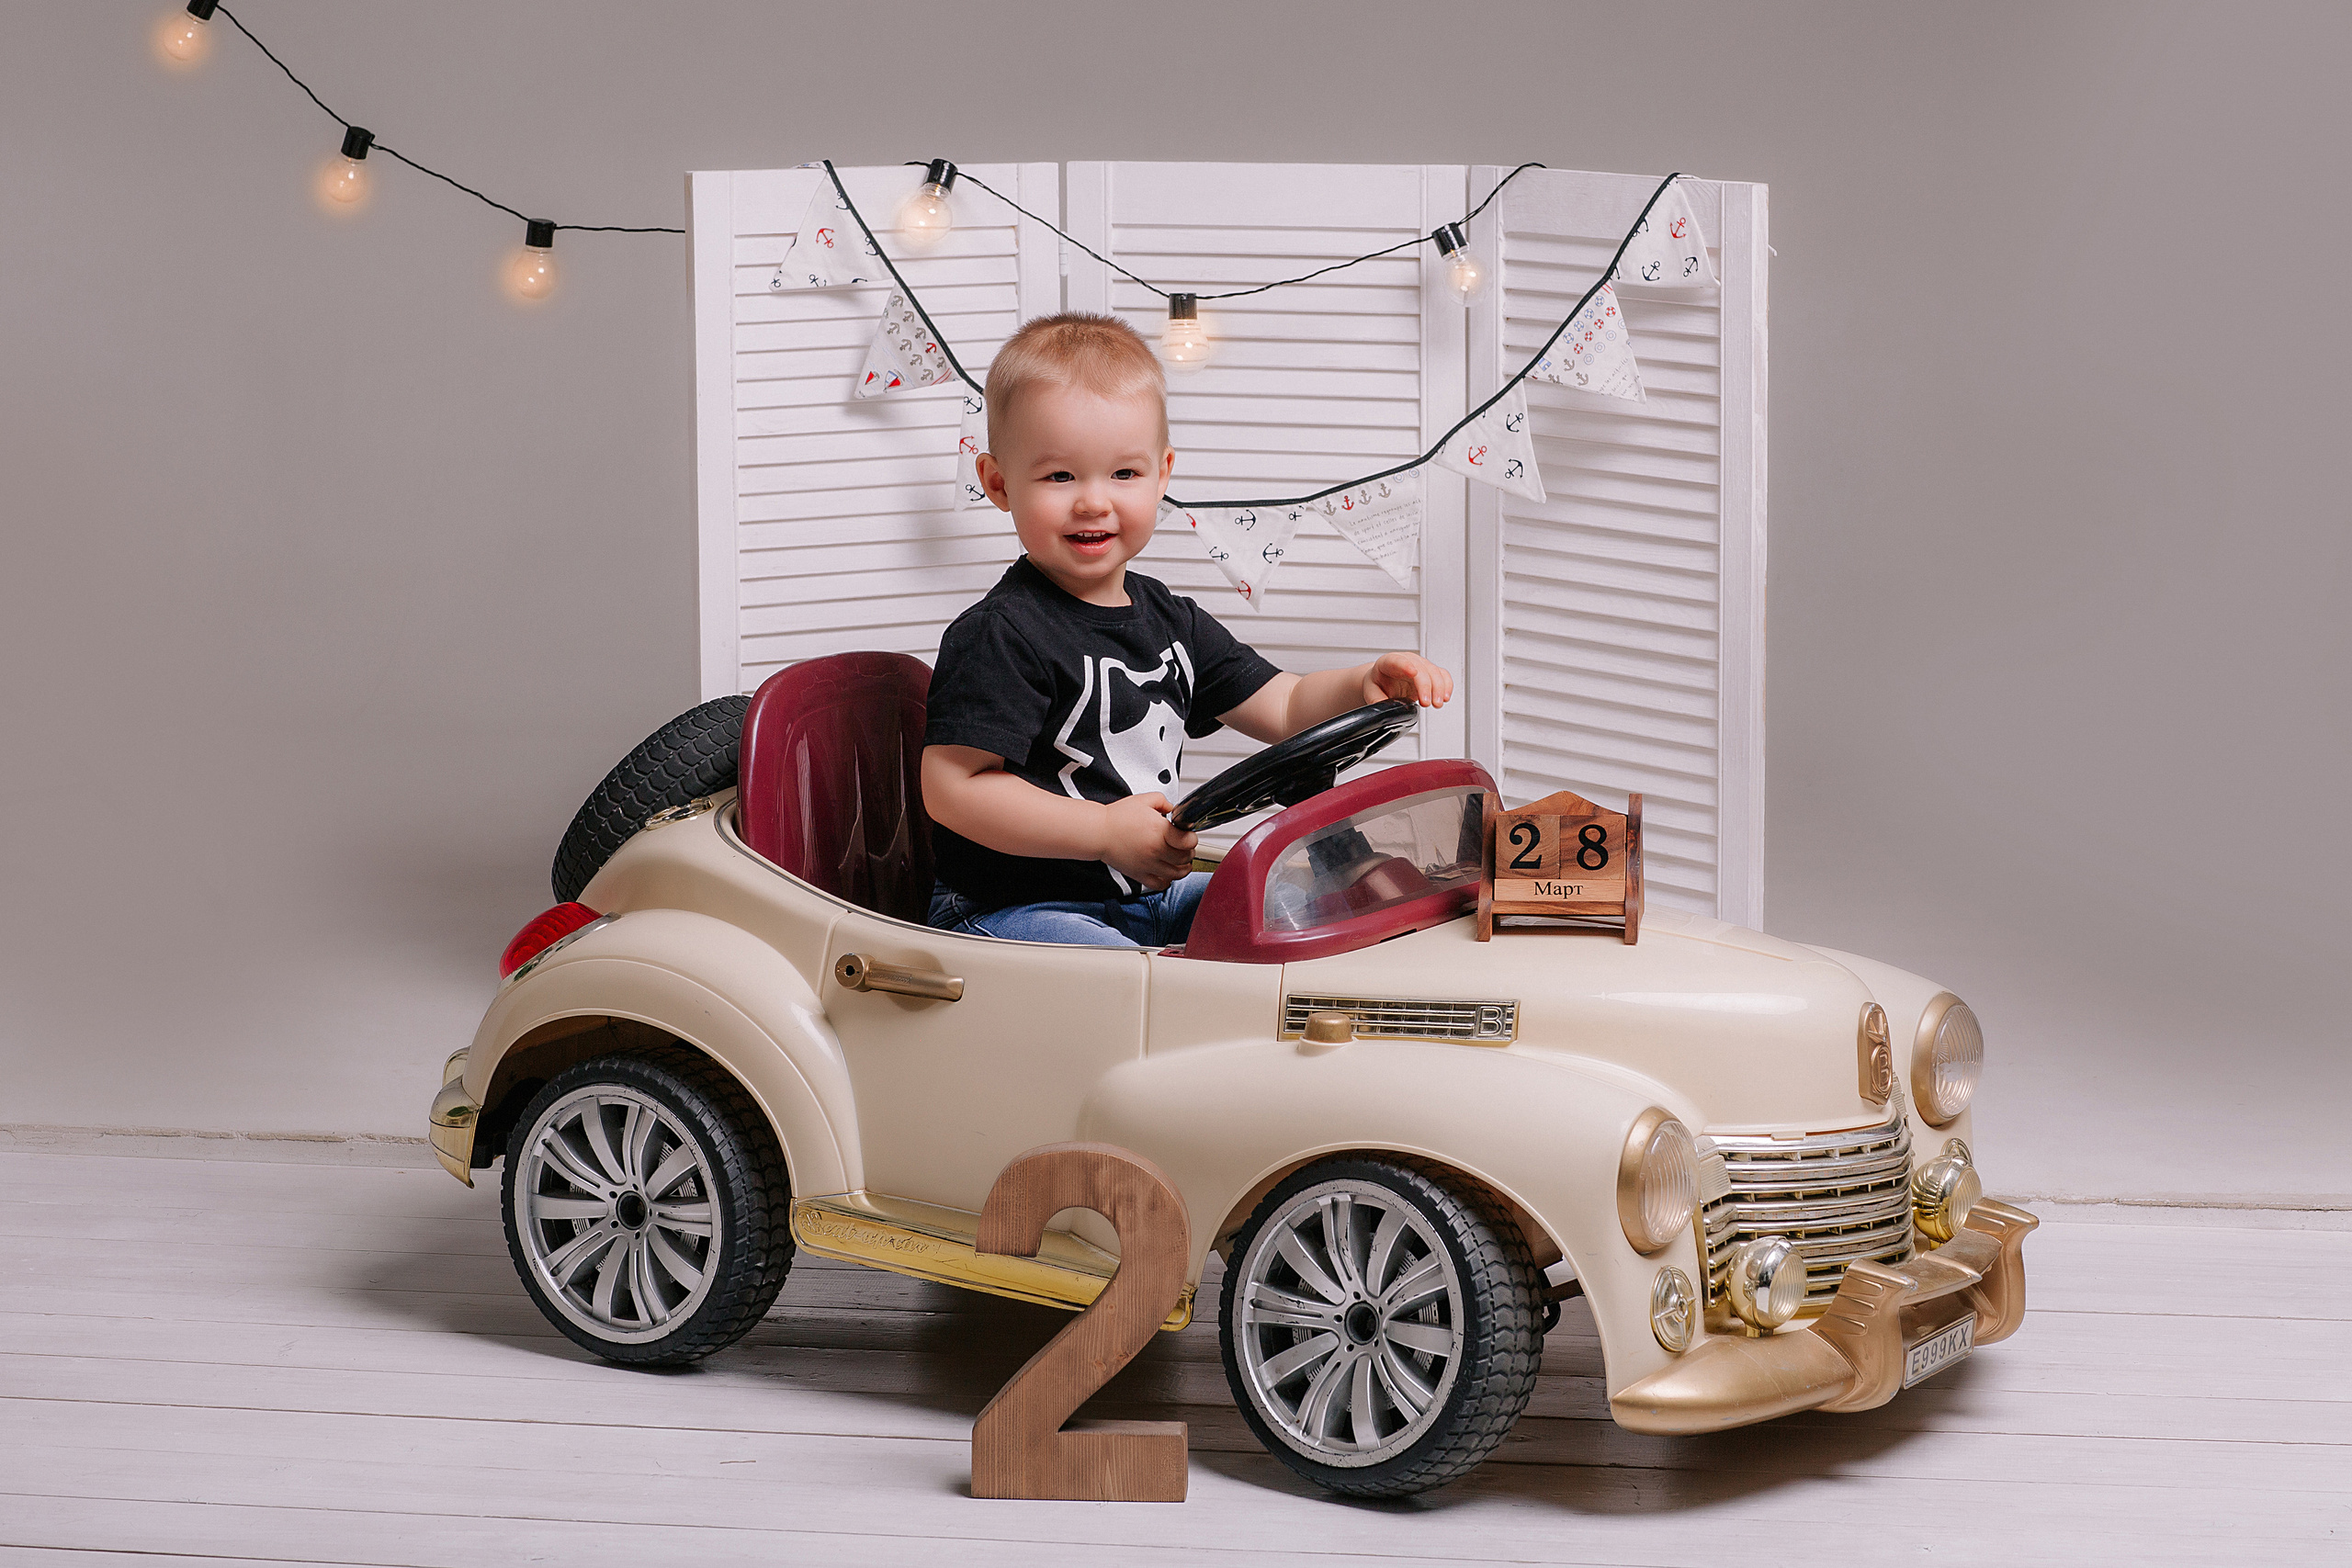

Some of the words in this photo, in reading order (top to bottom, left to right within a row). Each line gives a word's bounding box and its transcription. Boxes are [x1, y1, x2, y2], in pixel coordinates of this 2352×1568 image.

[1533, 881, 1584, 899] Март
[1479, 1005, 1503, 1038] B
[970, 1141, 1192, 1503] 2
[1911, 1325, 1970, 1376] E999KX
